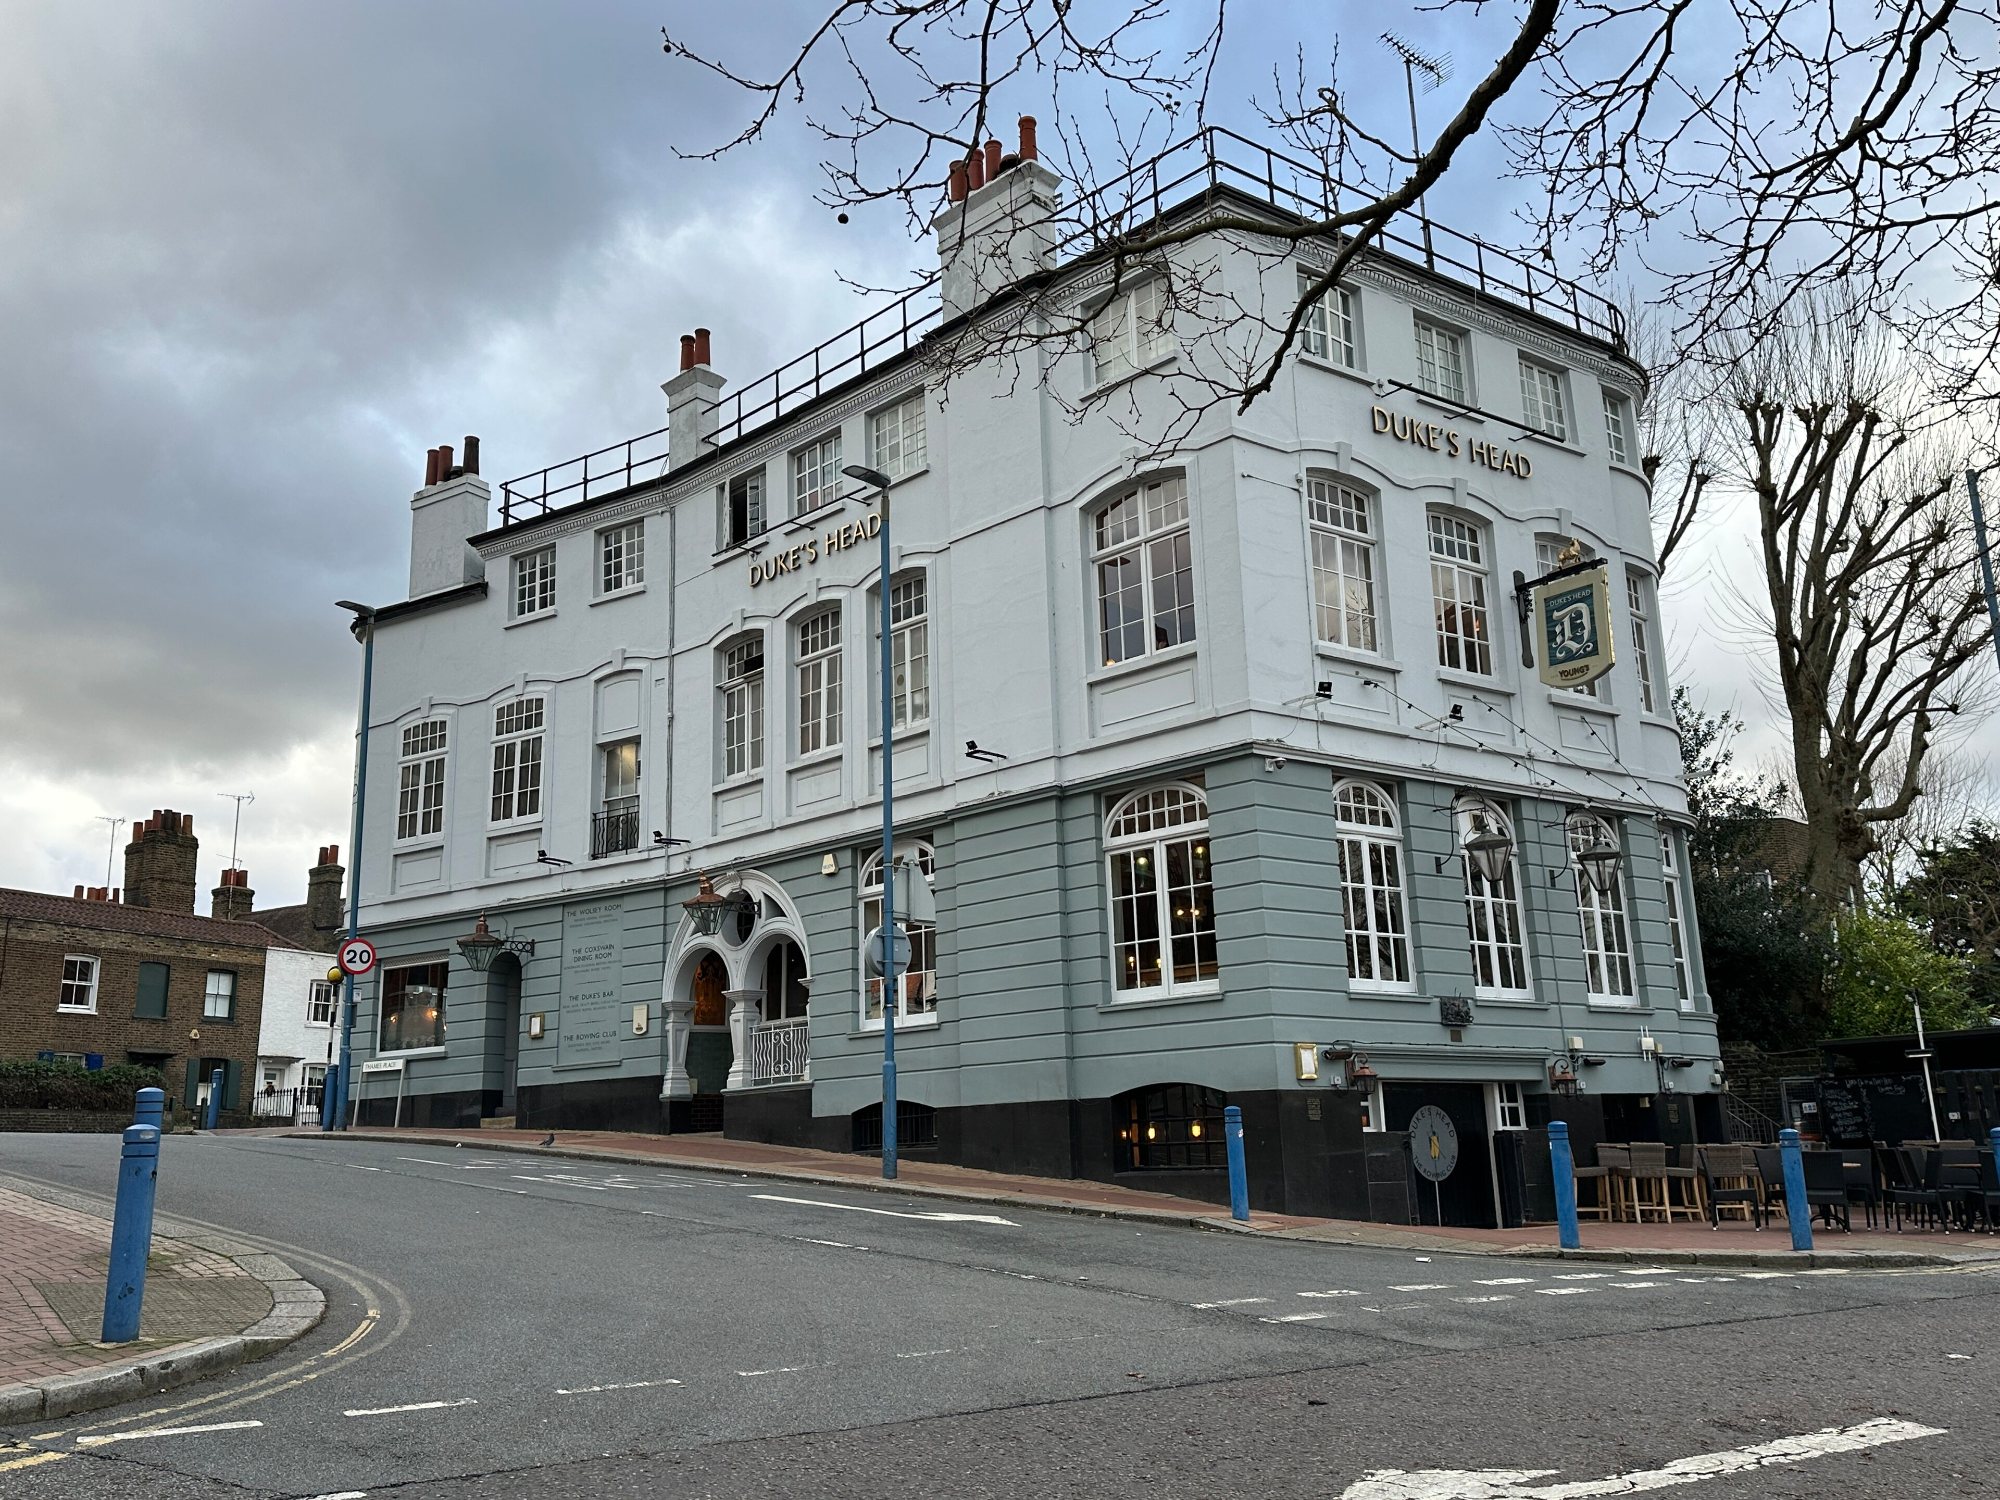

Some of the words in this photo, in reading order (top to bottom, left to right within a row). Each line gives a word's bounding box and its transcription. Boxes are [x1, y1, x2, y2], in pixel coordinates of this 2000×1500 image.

[1372, 406, 1461, 456] DUKE'S
[1469, 437, 1533, 478] HEAD
[749, 539, 817, 587] DUKE'S
[825, 512, 881, 556] HEAD
[1573, 589, 1591, 600] HEAD
[604, 904, 622, 912] ROOM
[584, 943, 615, 953] COXSWAIN
[346, 949, 371, 964] 20
[573, 954, 593, 963] DINING
[595, 952, 613, 961] ROOM
[576, 1032, 600, 1041] ROWING
[602, 1030, 617, 1038] CLUB
[1410, 1107, 1432, 1138] DUKE'S
[1436, 1109, 1455, 1138] HEAD
[1413, 1155, 1423, 1170] THE
[1446, 1154, 1457, 1172] CLUB
